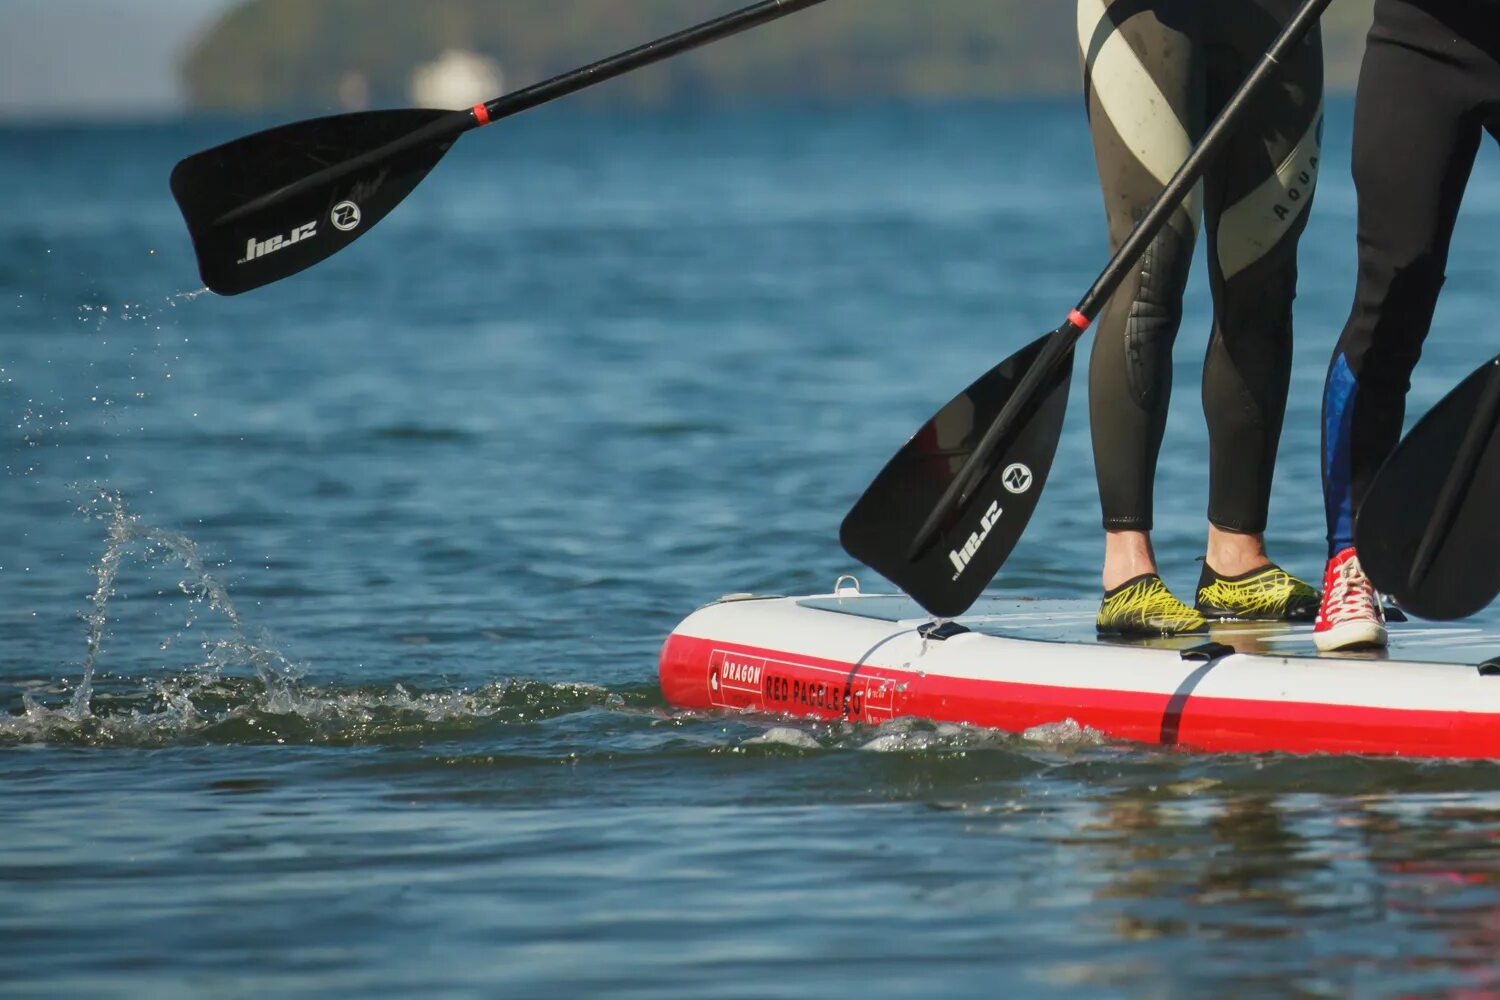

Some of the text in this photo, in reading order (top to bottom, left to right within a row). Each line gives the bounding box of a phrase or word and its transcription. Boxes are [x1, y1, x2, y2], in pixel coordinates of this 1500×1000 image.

[1273, 156, 1317, 221] AQUA
[723, 661, 761, 685] DRAGON
[766, 675, 788, 702] RED
